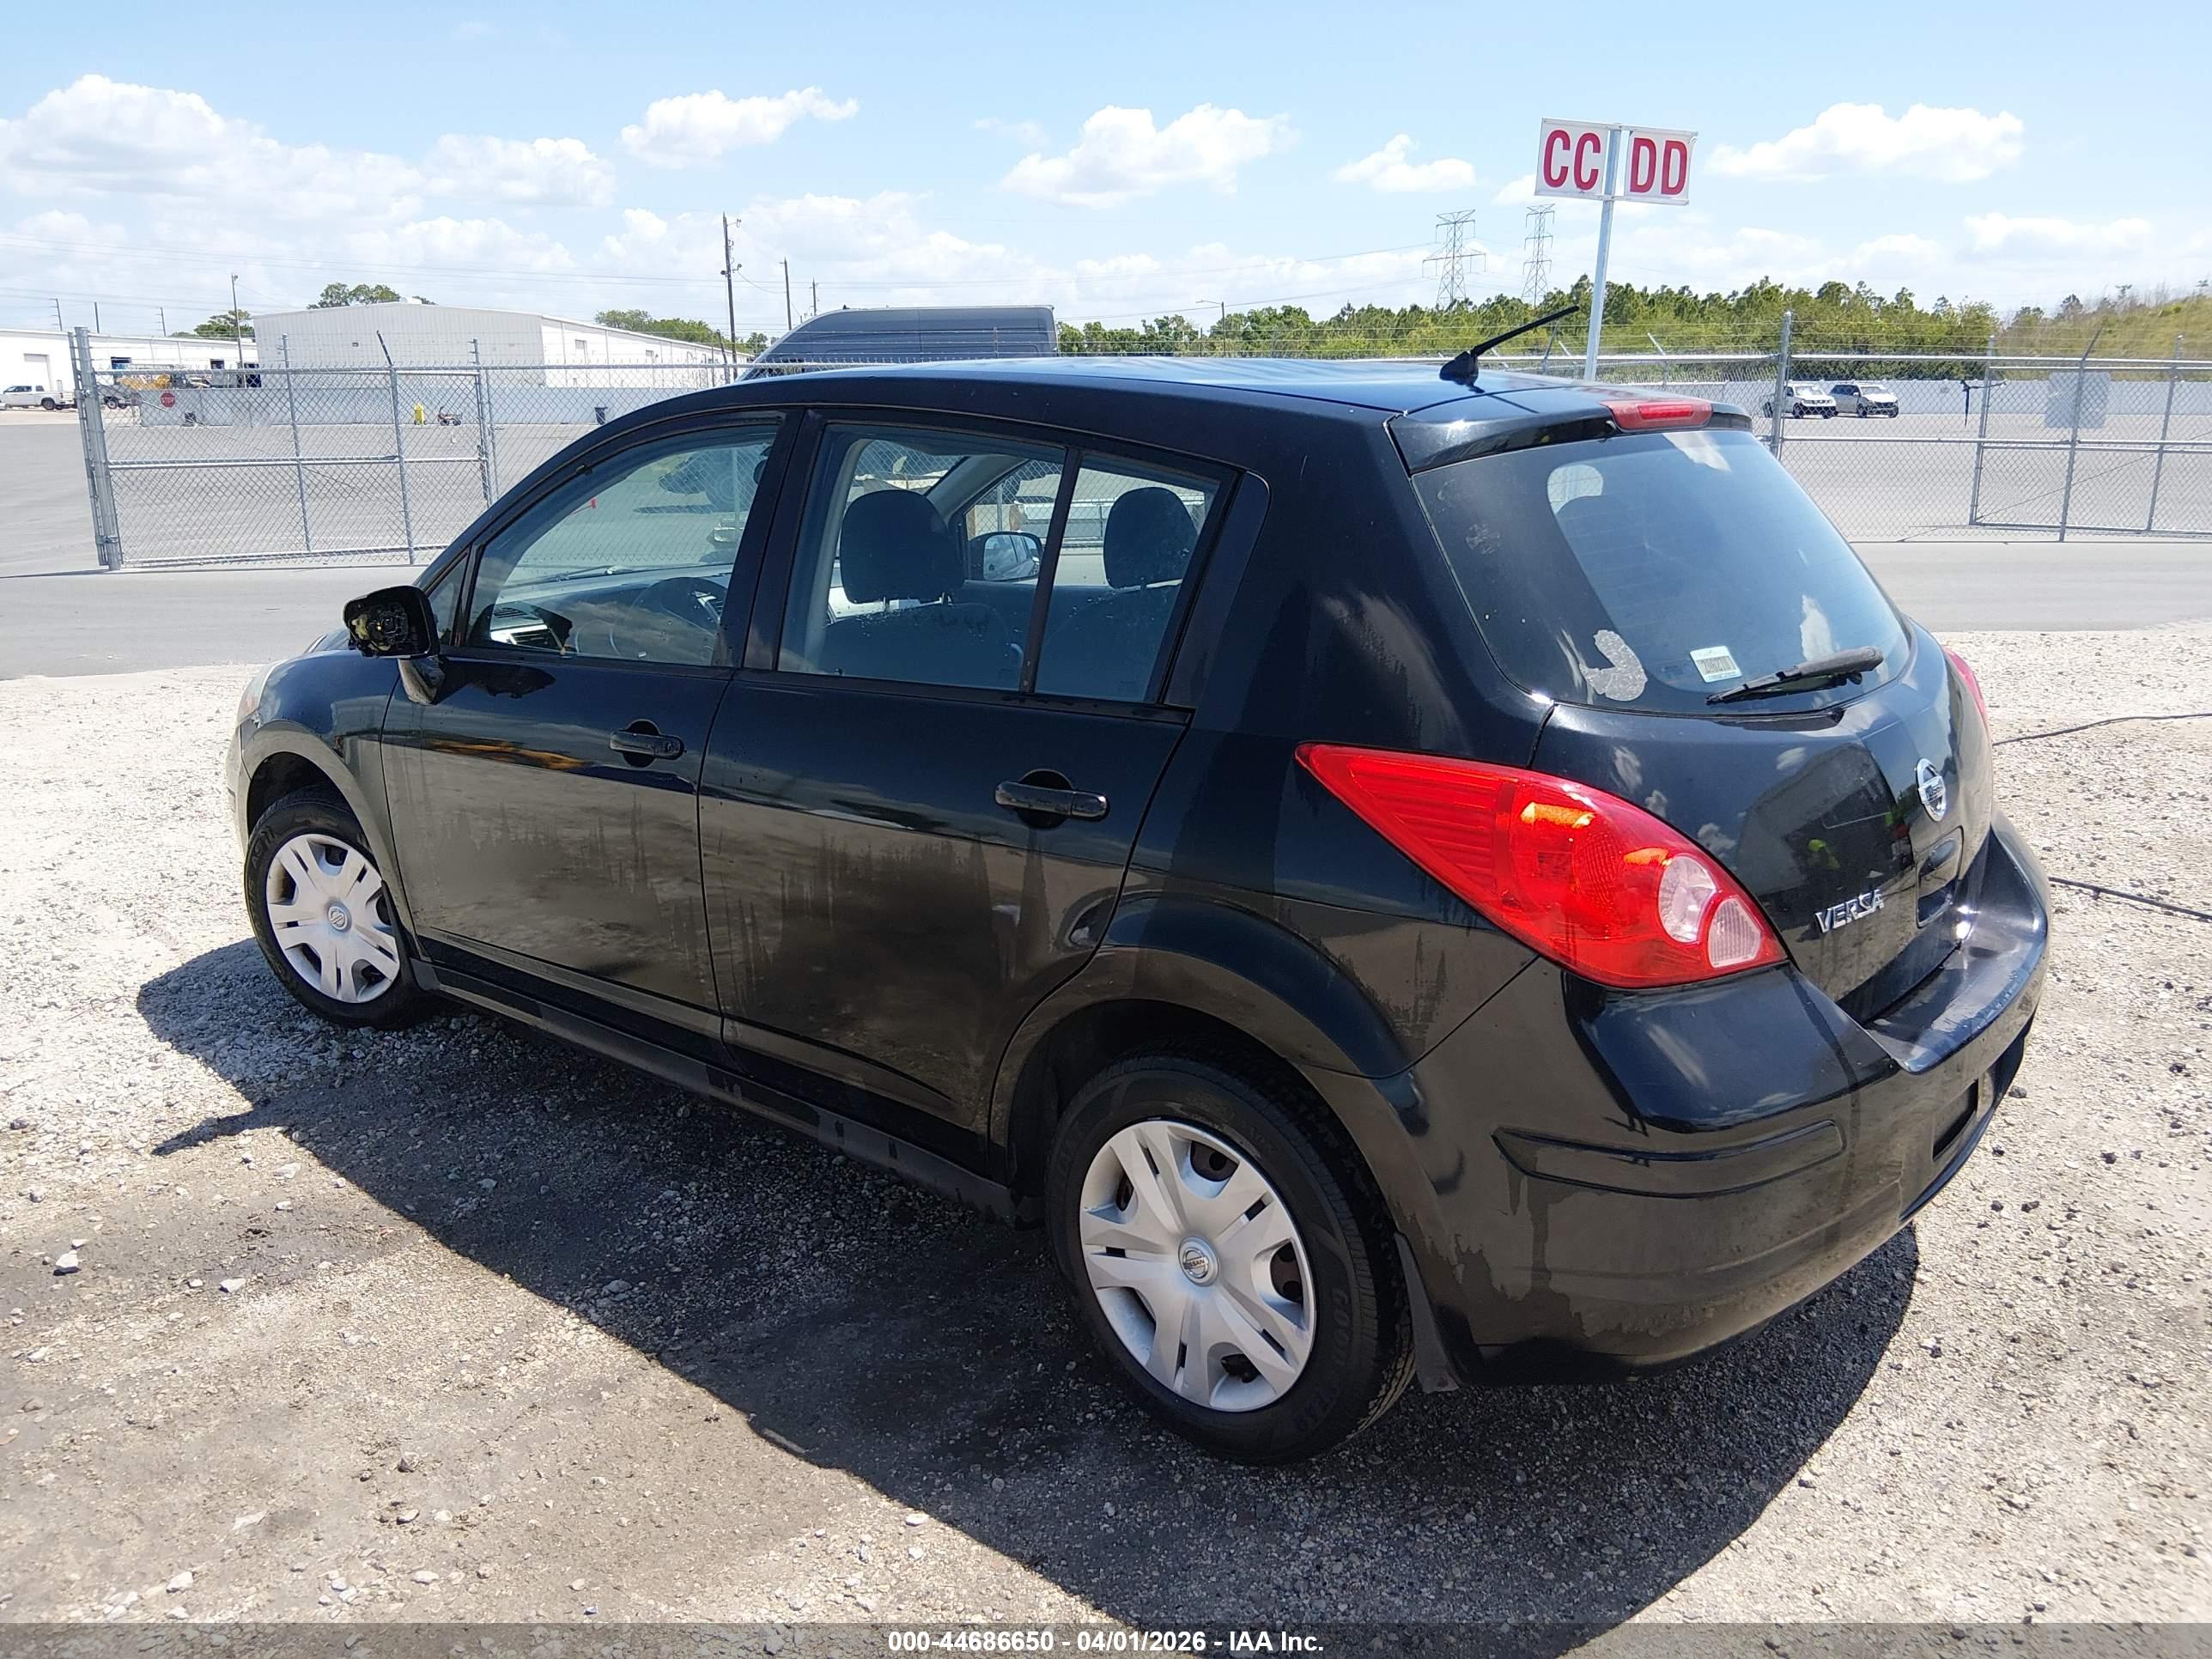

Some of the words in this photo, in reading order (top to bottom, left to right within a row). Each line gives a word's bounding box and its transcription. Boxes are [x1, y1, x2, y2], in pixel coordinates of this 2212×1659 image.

[1543, 129, 1601, 191] CC
[1629, 137, 1688, 196] DD
[1814, 889, 1885, 934] VERSA
